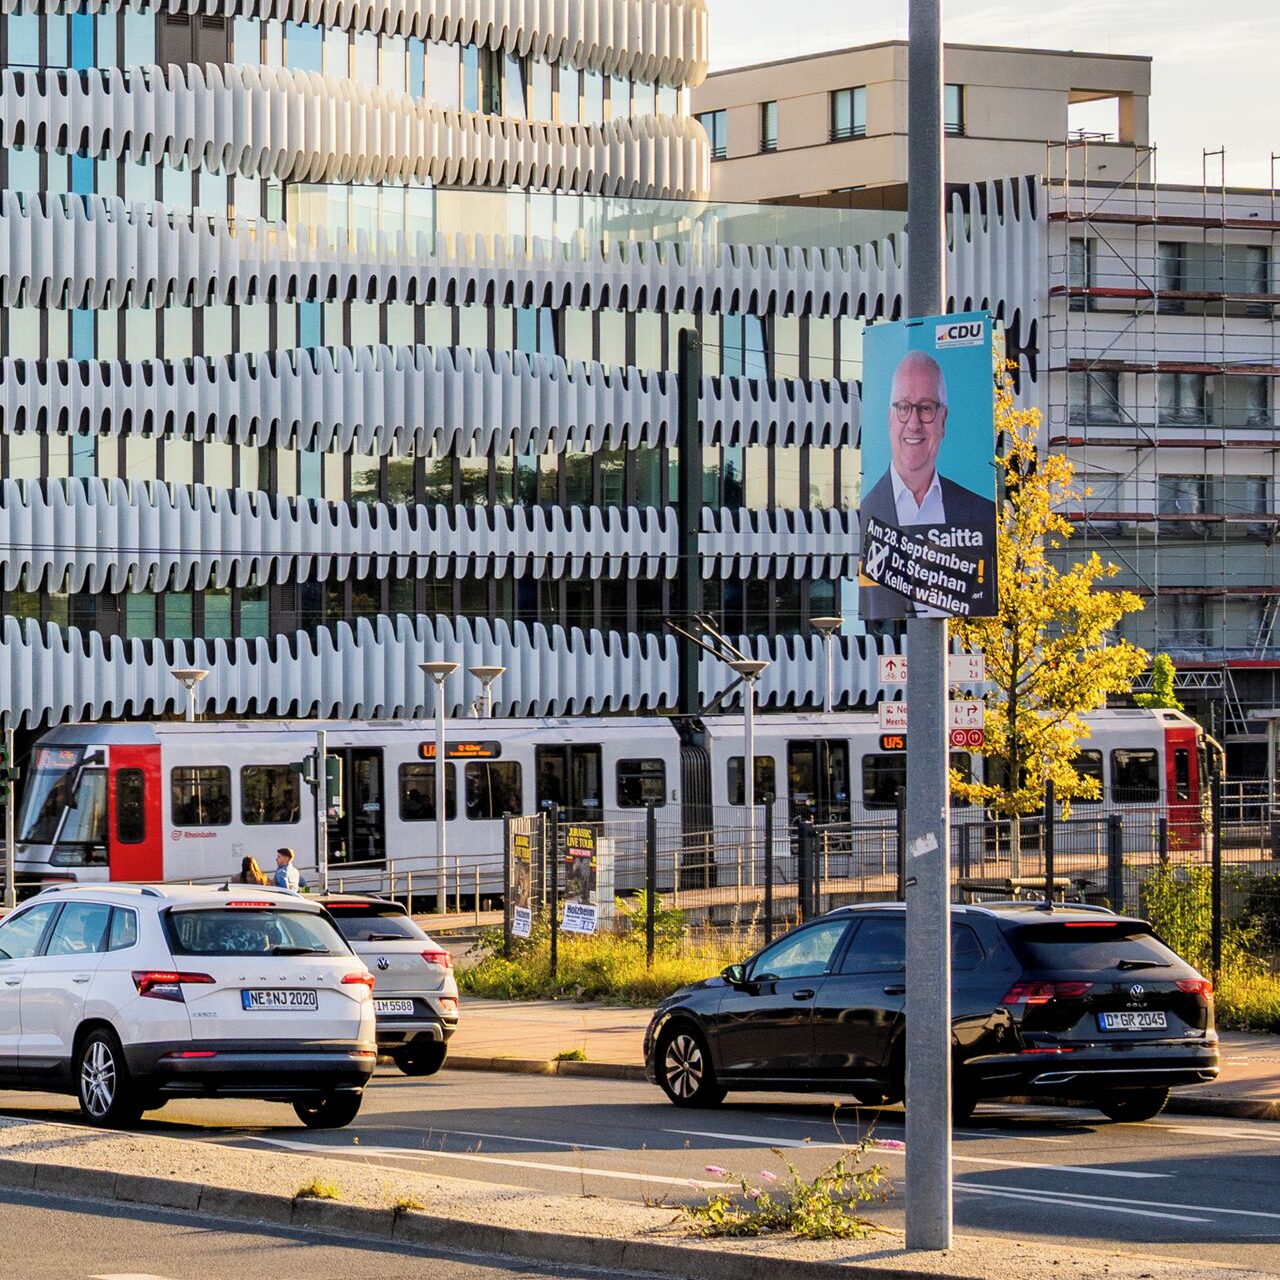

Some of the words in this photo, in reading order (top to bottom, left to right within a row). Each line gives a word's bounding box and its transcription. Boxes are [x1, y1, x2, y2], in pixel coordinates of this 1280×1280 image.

[948, 324, 981, 340] CDU
[927, 527, 983, 548] Saitta
[867, 519, 883, 539] Am
[883, 528, 899, 548] 28.
[900, 536, 977, 575] September
[891, 552, 905, 571] Dr.
[906, 560, 967, 593] Stephan
[884, 569, 913, 596] Keller
[915, 586, 970, 616] wählen
[883, 736, 904, 748] U75
[568, 827, 592, 839] JURASSIC
[566, 836, 579, 847] LIVE
[579, 838, 594, 849] TOUR
[566, 904, 595, 917] Holzheim
[250, 991, 266, 1005] NE
[272, 991, 288, 1005] NJ
[289, 992, 316, 1005] 2020
[389, 1001, 413, 1011] 5588
[1105, 1013, 1114, 1027] D
[1120, 1013, 1136, 1026] GR
[1137, 1013, 1165, 1026] 2045
